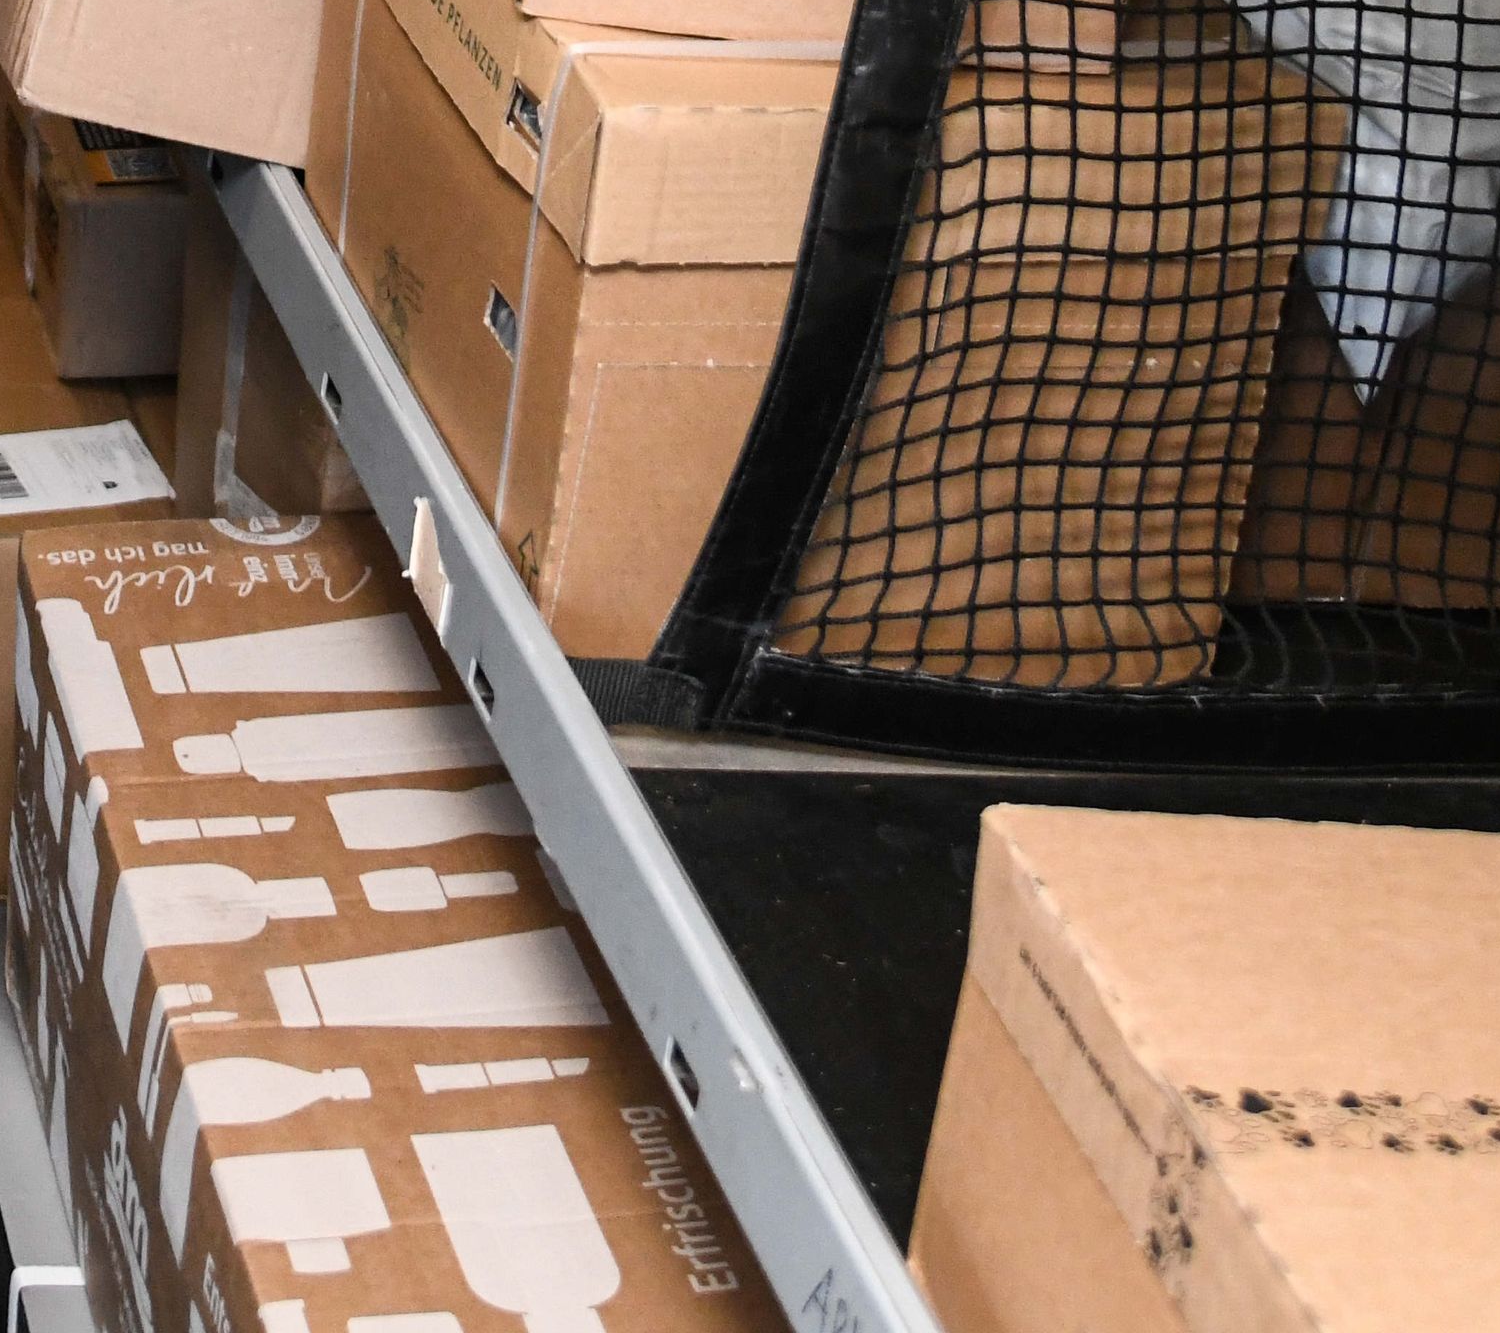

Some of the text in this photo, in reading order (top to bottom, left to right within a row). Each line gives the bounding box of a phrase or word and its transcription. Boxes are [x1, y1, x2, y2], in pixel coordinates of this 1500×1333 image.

[445, 2, 502, 91] PFLANZEN
[37, 547, 95, 567] das.
[620, 1105, 740, 1293] Erfrischung
